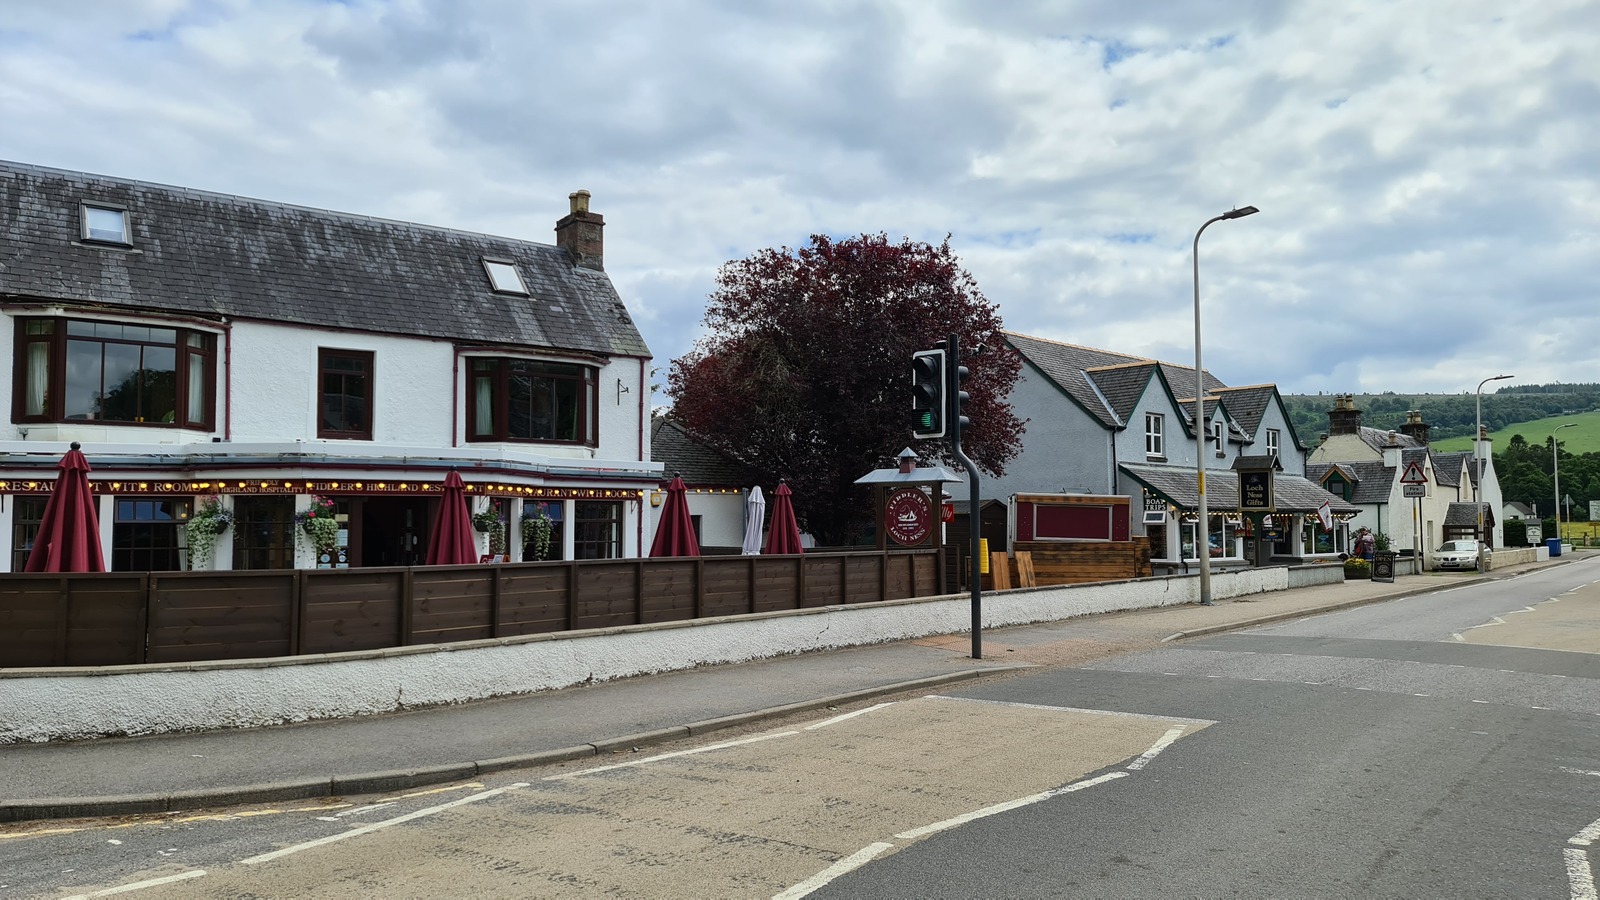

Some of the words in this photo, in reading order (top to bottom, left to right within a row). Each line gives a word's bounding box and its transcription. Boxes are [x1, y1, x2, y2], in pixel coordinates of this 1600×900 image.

[1, 481, 102, 492] RESTAUT
[107, 482, 148, 492] WITH
[153, 482, 201, 492] ROOMS
[221, 486, 257, 494] HIGHLAND
[259, 486, 304, 494] HOSPITALITY
[366, 483, 419, 492] HIGHLAND
[890, 526, 907, 541] LOCH
[909, 527, 926, 541] NESS
